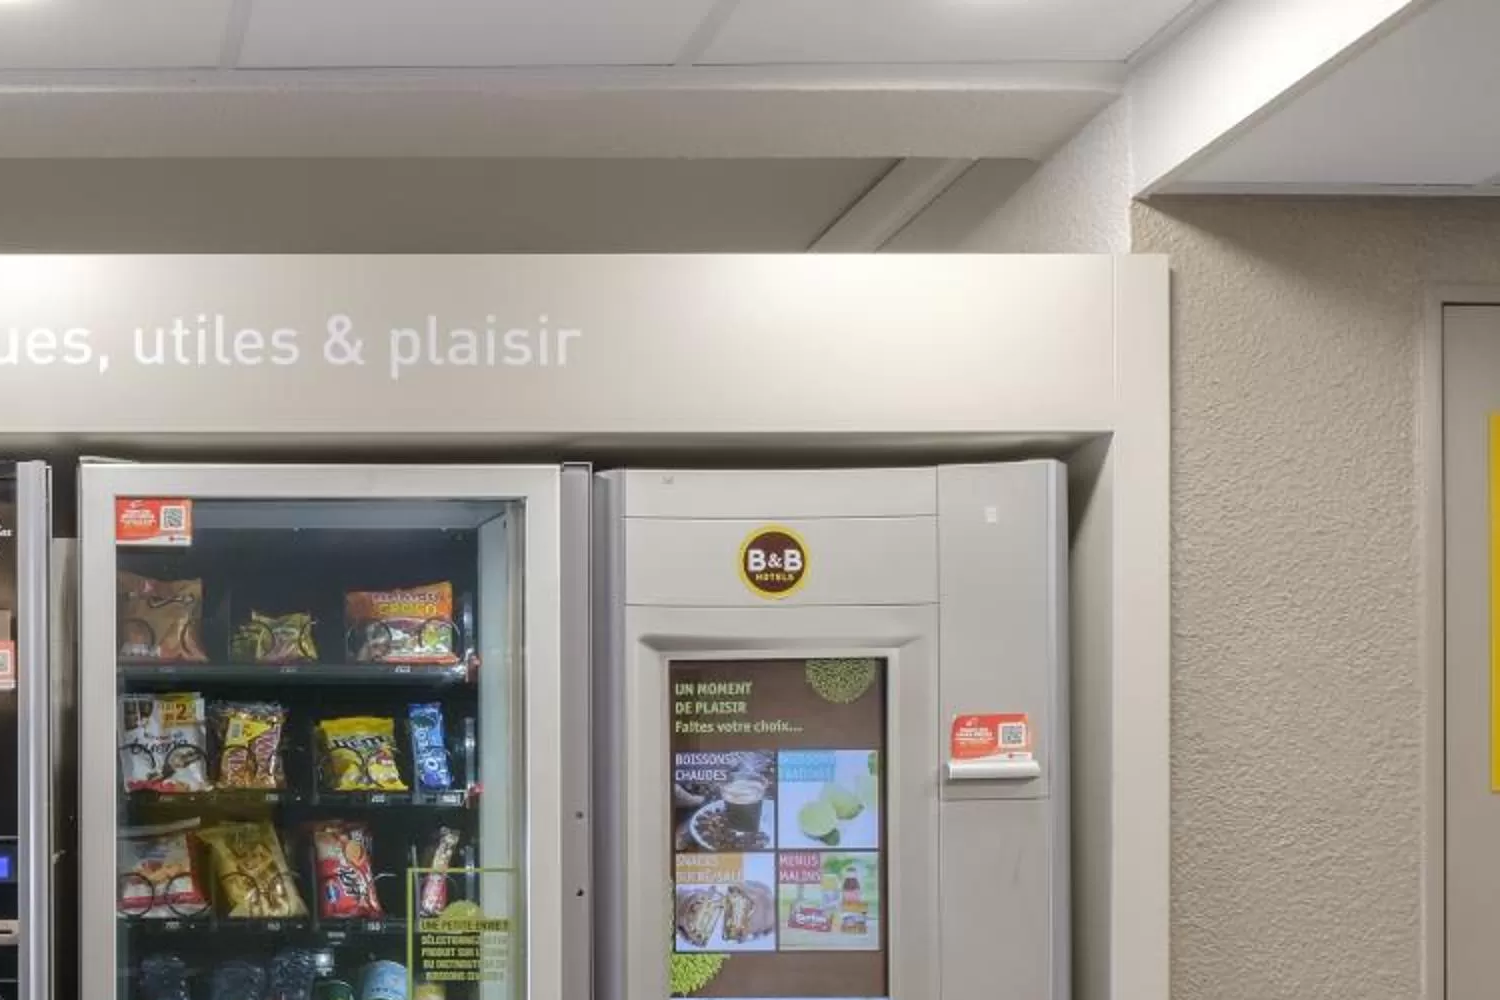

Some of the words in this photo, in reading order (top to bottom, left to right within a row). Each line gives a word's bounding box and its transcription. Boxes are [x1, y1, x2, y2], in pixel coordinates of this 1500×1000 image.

[133, 313, 300, 367] utiles
[323, 313, 366, 366] &
[389, 314, 582, 380] plaisir
[747, 548, 803, 572] B&B
[675, 682, 694, 695] UN
[697, 682, 752, 695] MOMENT
[675, 701, 693, 714] DE
[695, 701, 748, 714] PLAISIR
[675, 721, 714, 733] Faites
[716, 721, 753, 733] votre
[675, 769, 727, 781] CHAUDES
